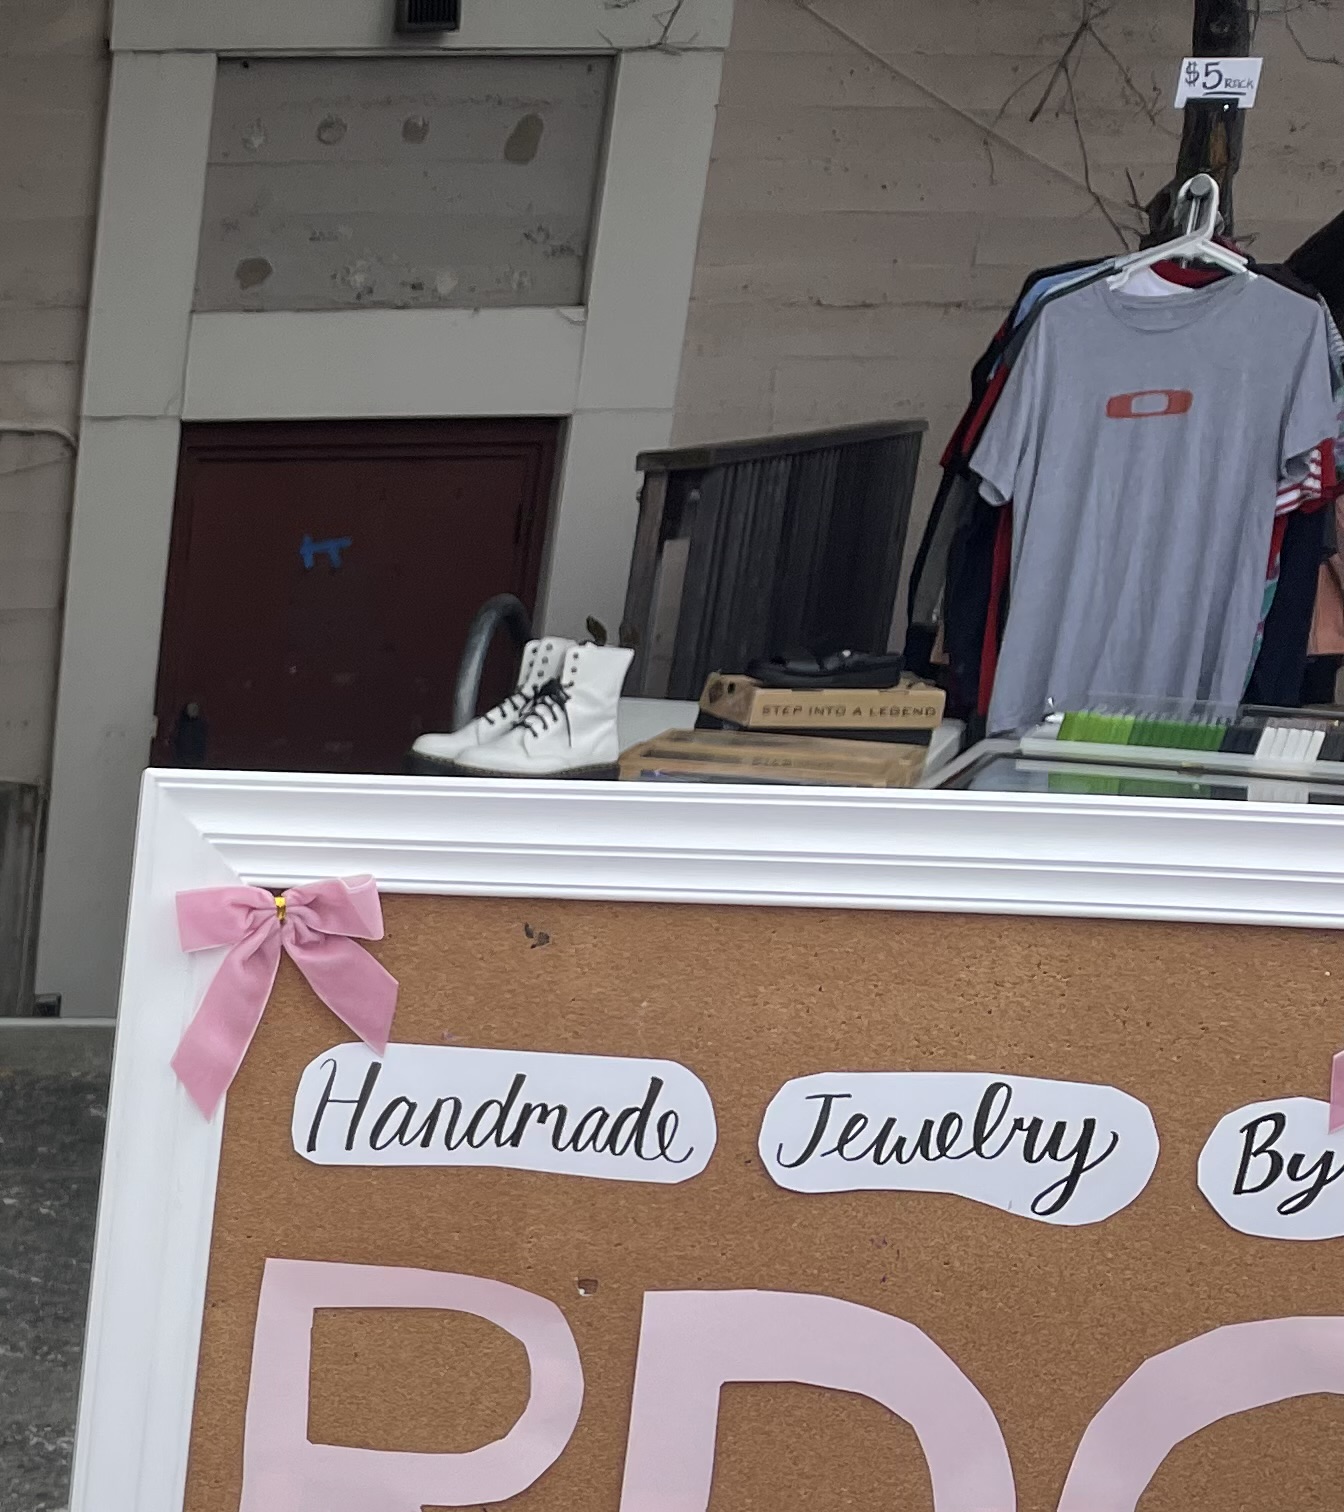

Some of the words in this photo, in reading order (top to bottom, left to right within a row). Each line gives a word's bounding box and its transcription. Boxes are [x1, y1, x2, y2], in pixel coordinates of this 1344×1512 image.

[1185, 61, 1223, 90] $5
[809, 704, 847, 717] INTO
[852, 705, 863, 717] A
[307, 1060, 696, 1164] Handmade
[776, 1081, 1118, 1218] Jewelry
[1233, 1111, 1344, 1216] By
